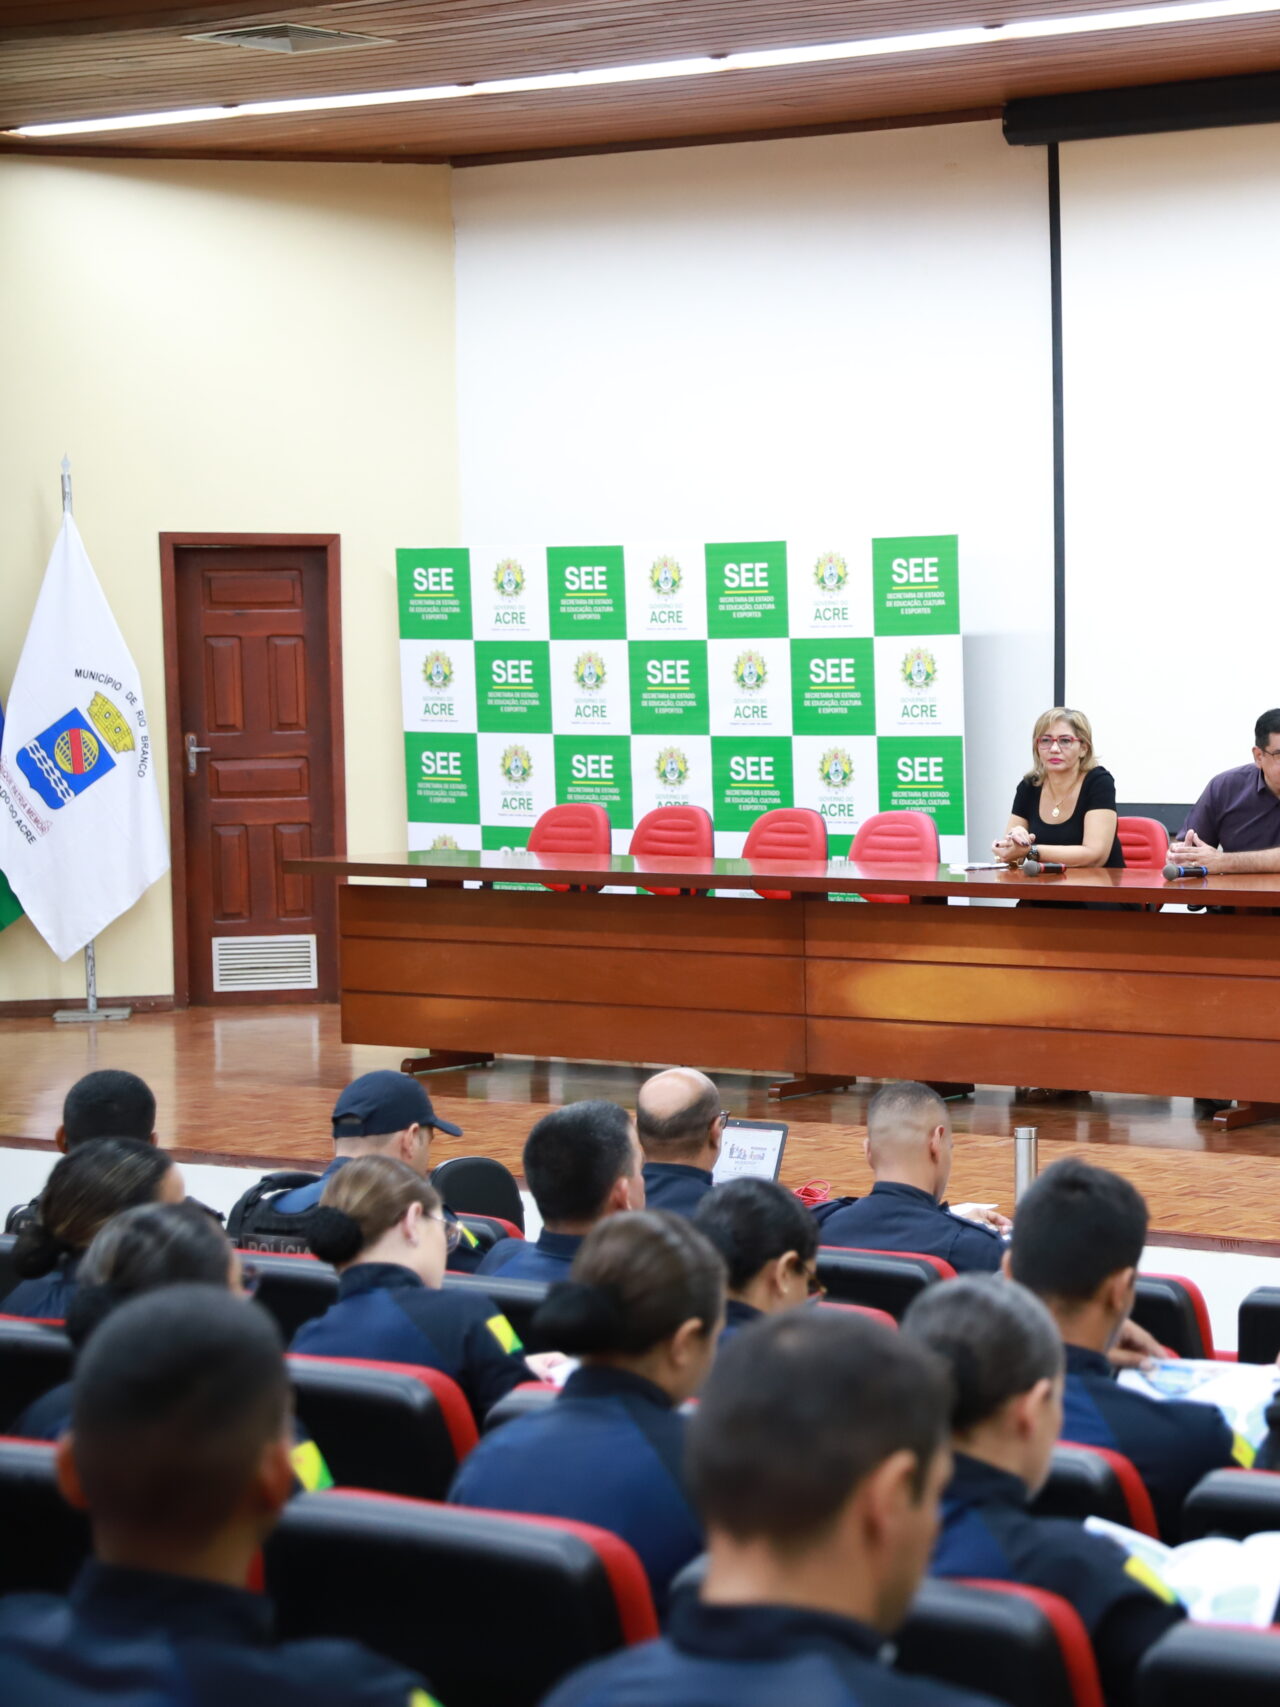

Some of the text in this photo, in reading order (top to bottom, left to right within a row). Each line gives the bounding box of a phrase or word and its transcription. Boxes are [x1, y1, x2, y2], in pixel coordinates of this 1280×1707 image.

[413, 567, 453, 590] SEE
[564, 566, 606, 590] SEE
[723, 562, 768, 587] SEE
[892, 556, 938, 583] SEE
[494, 611, 526, 624] ACRE
[649, 610, 683, 623] ACRE
[813, 606, 848, 620] ACRE
[491, 659, 533, 684] SEE
[645, 660, 690, 684] SEE
[808, 657, 855, 683] SEE
[424, 703, 455, 716] ACRE
[574, 705, 607, 717] ACRE
[733, 705, 767, 718] ACRE
[900, 704, 936, 718] ACRE
[74, 668, 149, 778] MUNICÍPIO DE RIO BRANCO
[421, 751, 461, 775] SEE
[571, 754, 613, 778] SEE
[729, 756, 774, 781] SEE
[896, 756, 943, 782] SEE
[501, 797, 533, 810] ACRE
[818, 803, 853, 816] ACRE
[16, 819, 36, 844] ACRE
